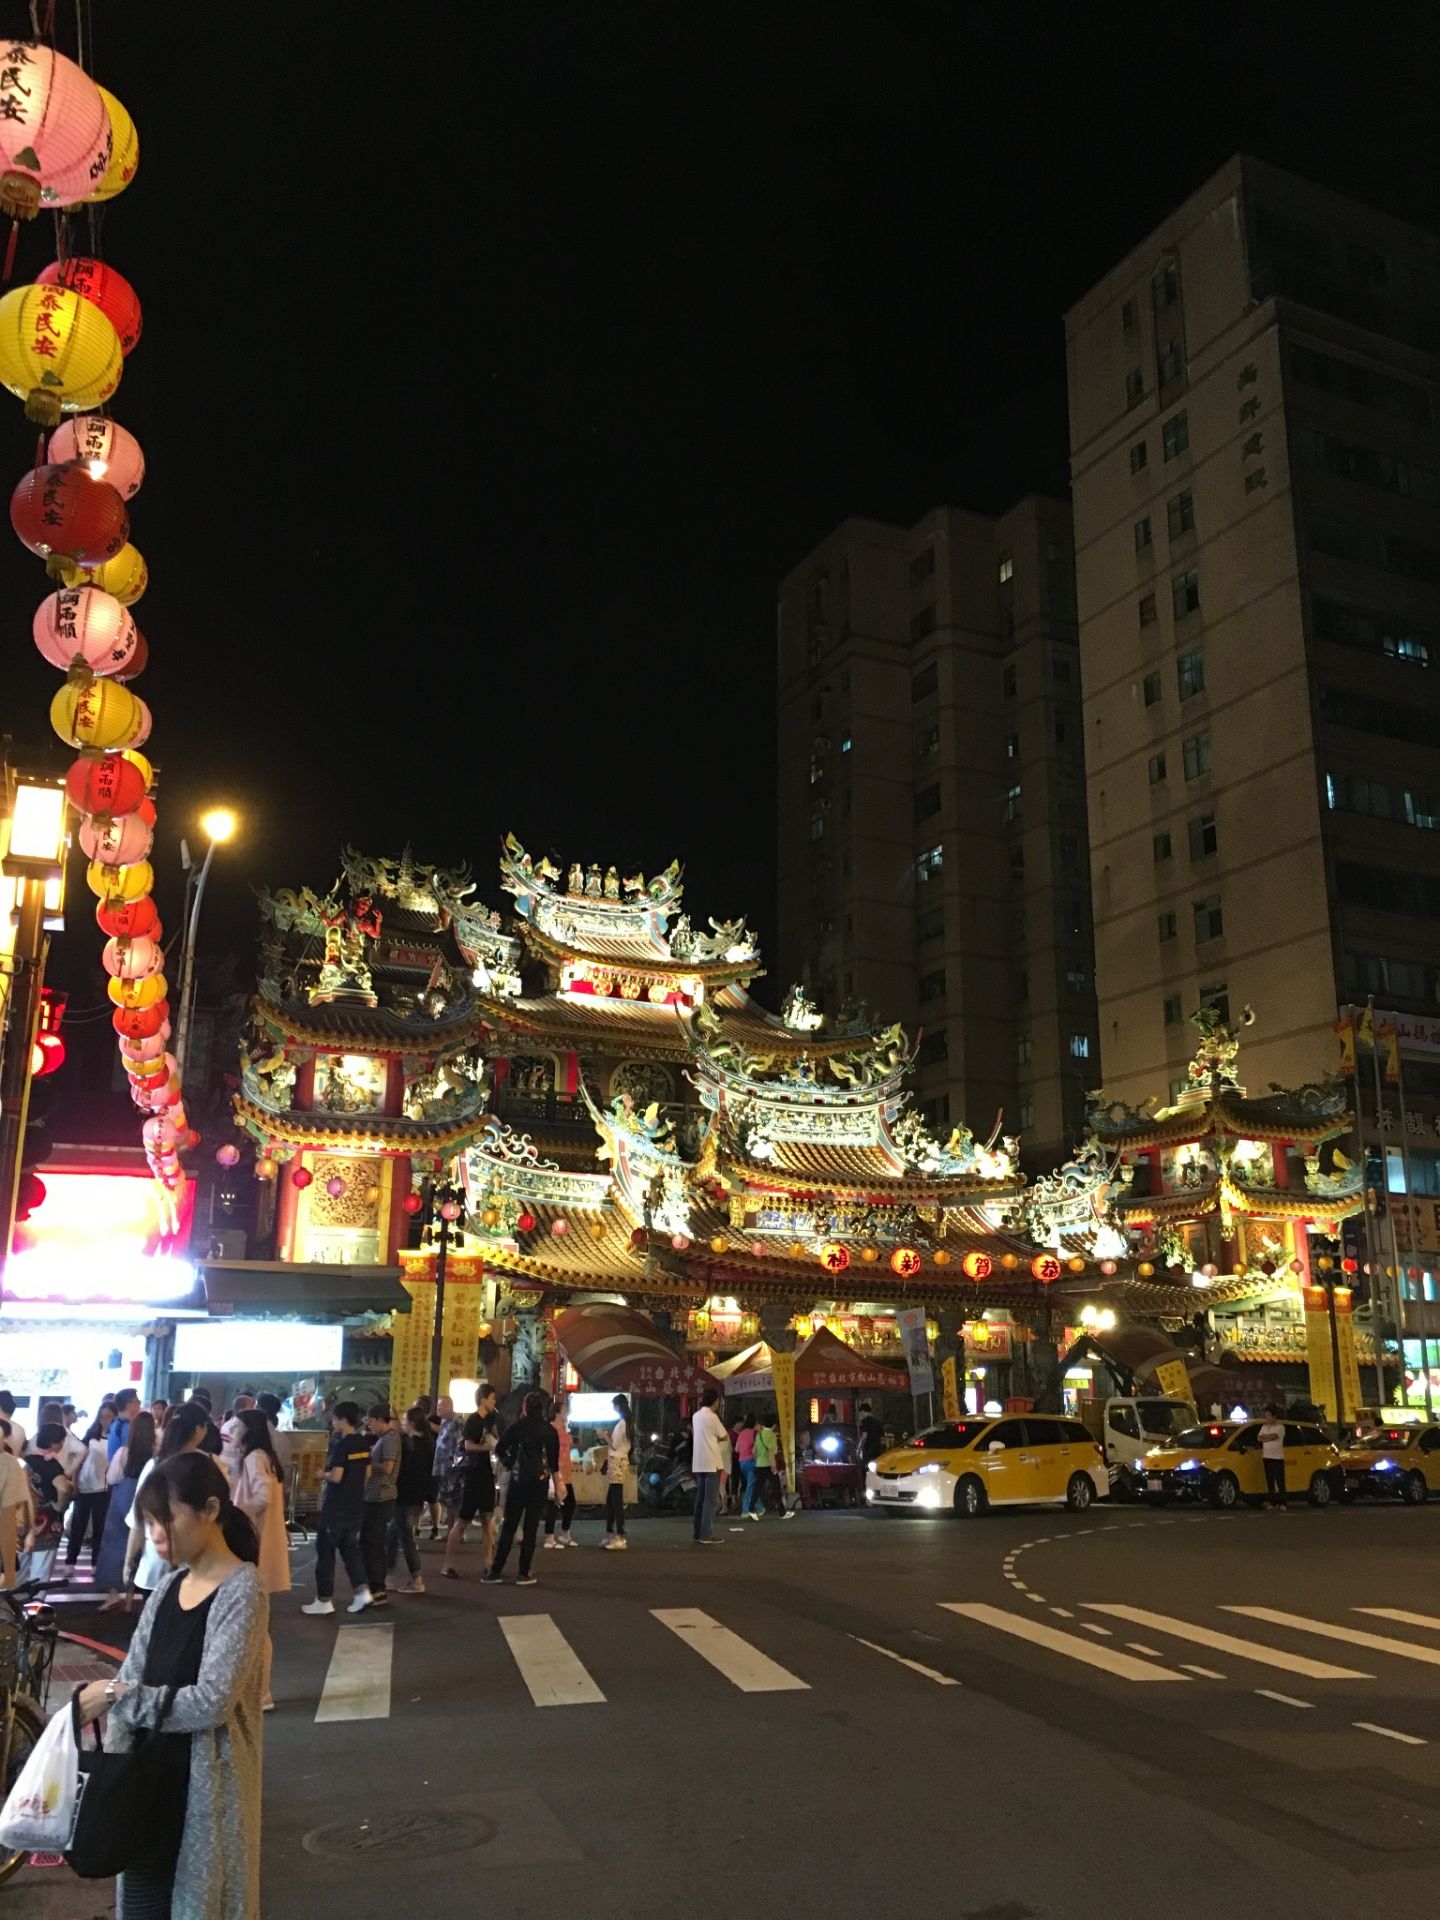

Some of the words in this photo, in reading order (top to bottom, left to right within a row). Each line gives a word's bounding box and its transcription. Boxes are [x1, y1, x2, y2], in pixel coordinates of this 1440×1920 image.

[0, 41, 37, 125] 泰民安
[41, 465, 70, 527] 泰民安
[60, 588, 80, 639] 調雨順
[77, 680, 97, 728] 泰民安
[901, 1252, 920, 1271] 新
[975, 1256, 991, 1275] 賀
[1041, 1260, 1060, 1278] 恭
